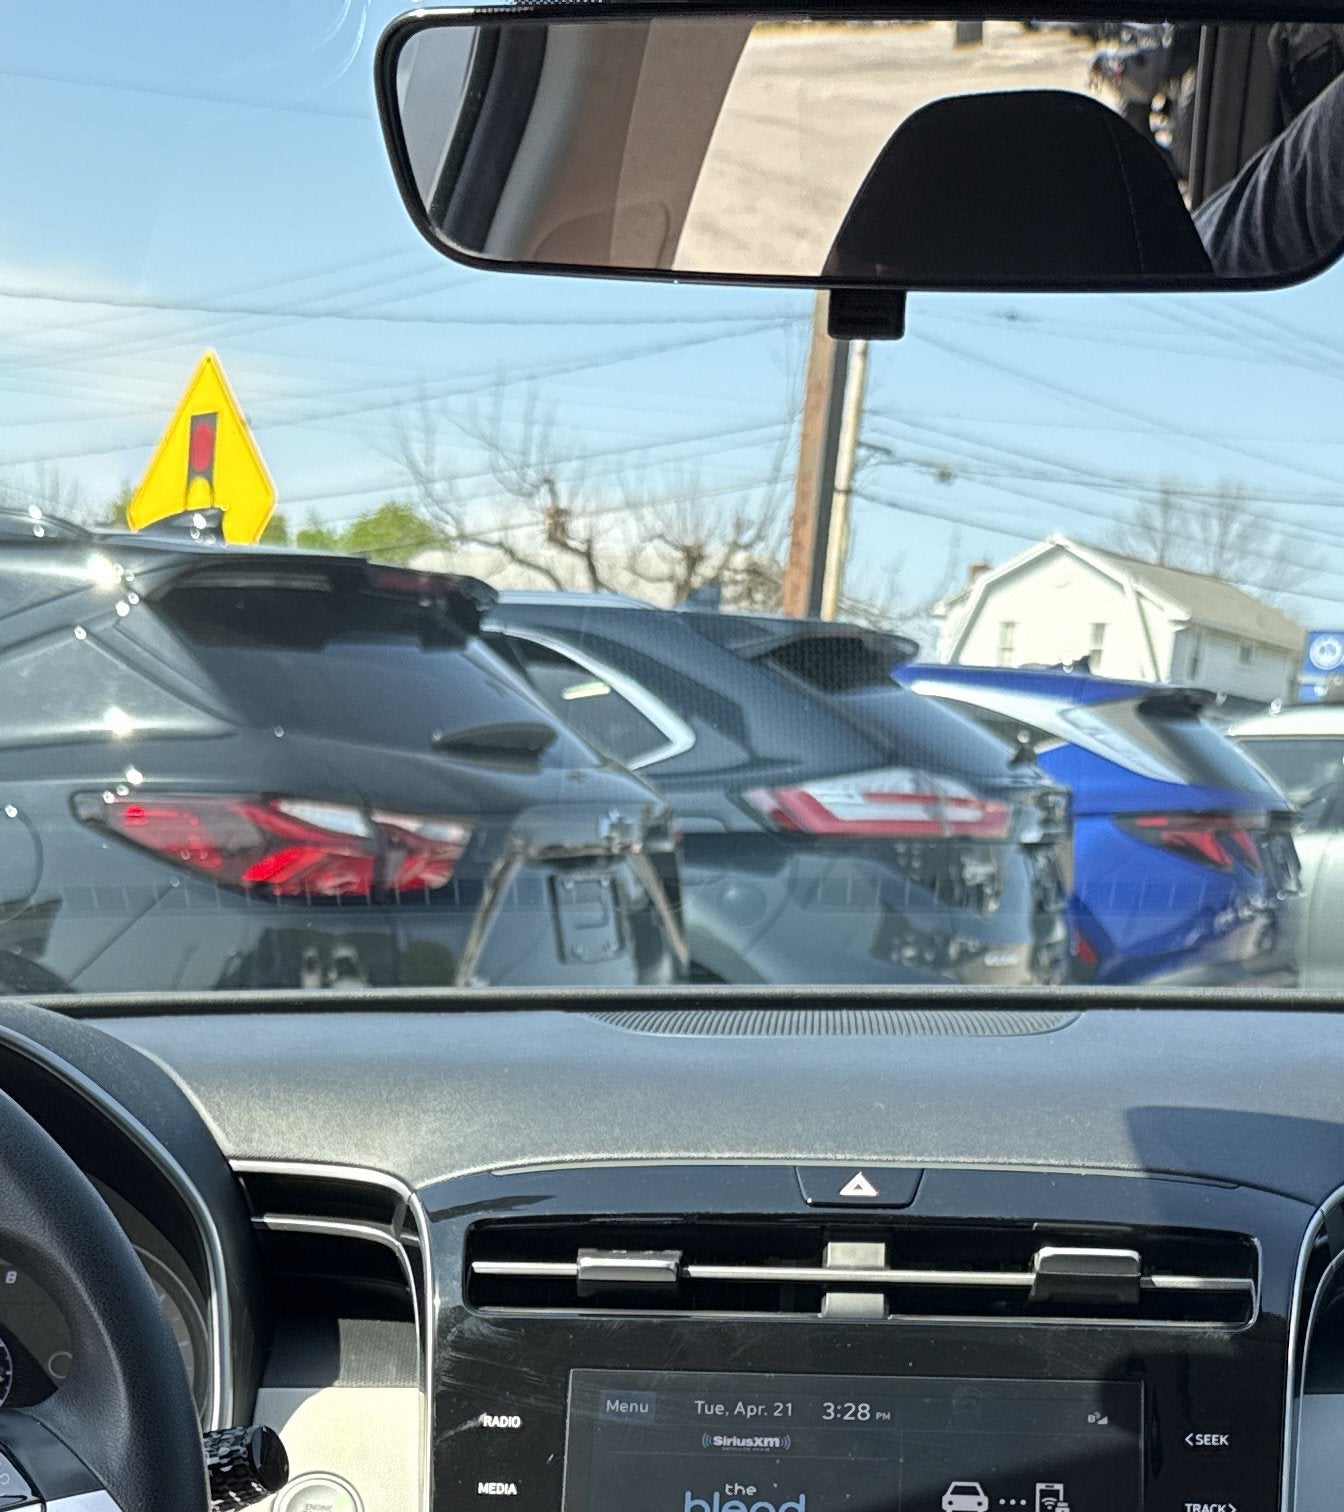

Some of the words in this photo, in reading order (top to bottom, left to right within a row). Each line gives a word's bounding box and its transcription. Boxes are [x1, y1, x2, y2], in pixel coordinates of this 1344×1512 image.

[606, 1399, 649, 1414] Menu
[694, 1400, 729, 1417] Tue,
[733, 1401, 768, 1419] Apr.
[773, 1402, 794, 1418] 21
[822, 1402, 872, 1421] 3:28
[875, 1411, 892, 1421] PM
[482, 1415, 523, 1429] RADIO
[1195, 1433, 1230, 1447] SEEK
[477, 1482, 518, 1496] MEDIA
[725, 1482, 757, 1497] the
